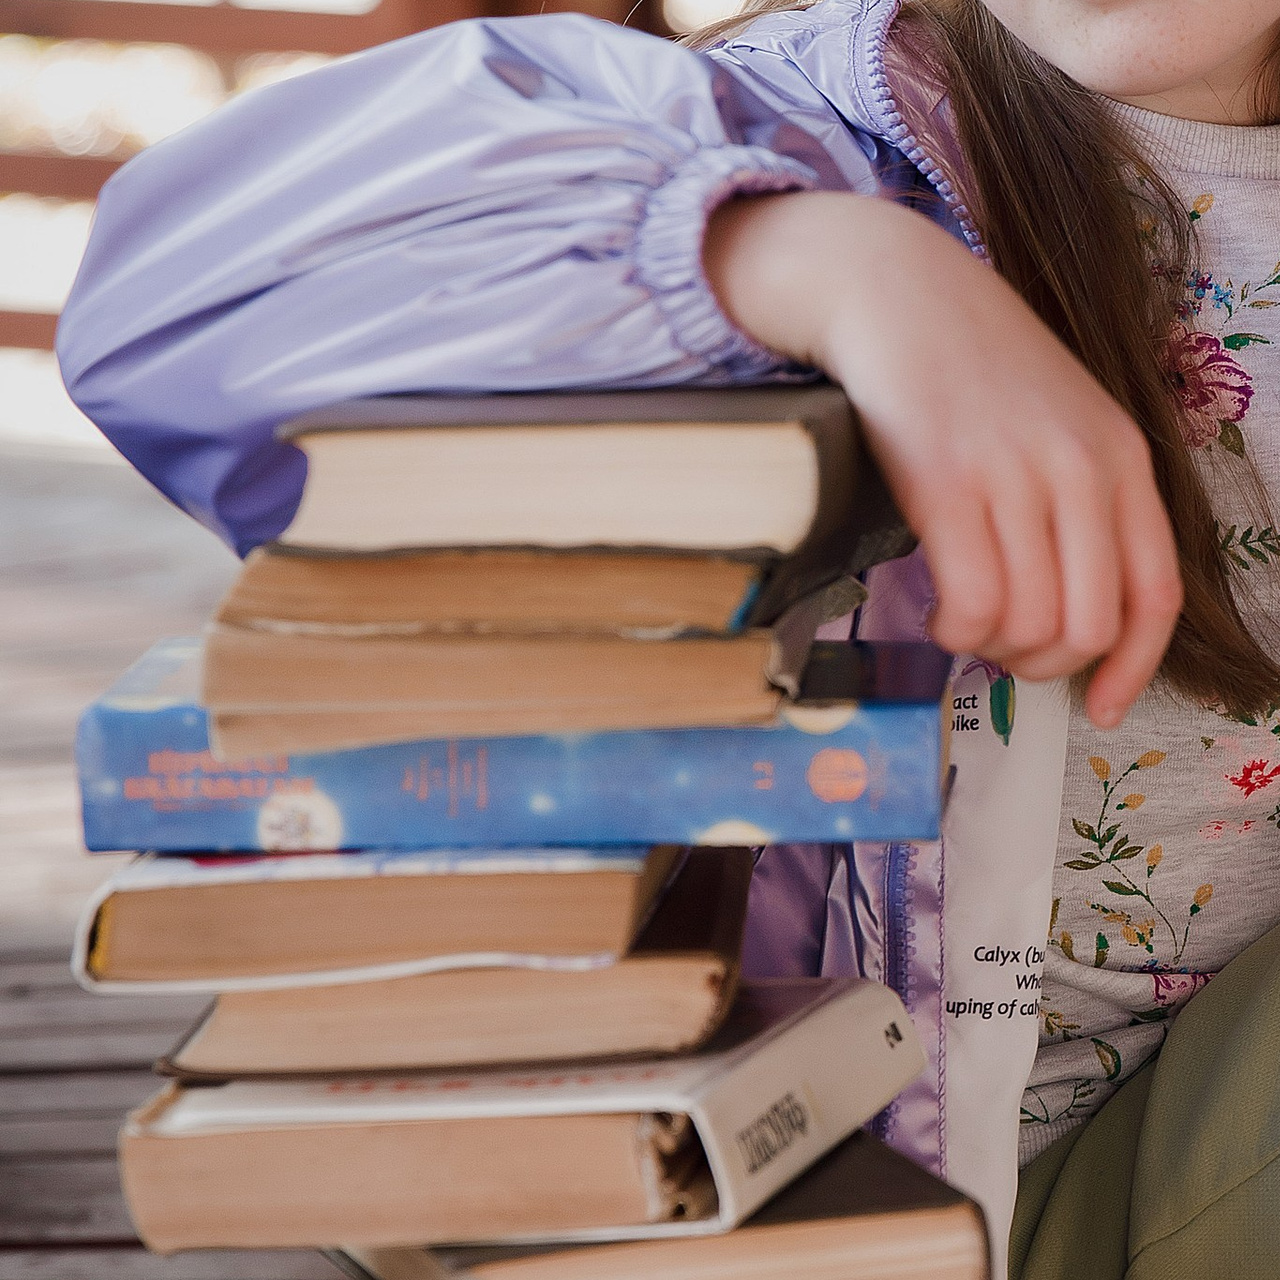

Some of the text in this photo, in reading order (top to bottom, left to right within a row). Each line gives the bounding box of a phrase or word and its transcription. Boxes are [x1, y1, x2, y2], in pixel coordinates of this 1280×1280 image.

[953, 694, 979, 710] act
[974, 946, 1021, 966] Calyx
[946, 998, 995, 1020] uping
[997, 999, 1018, 1019] of
